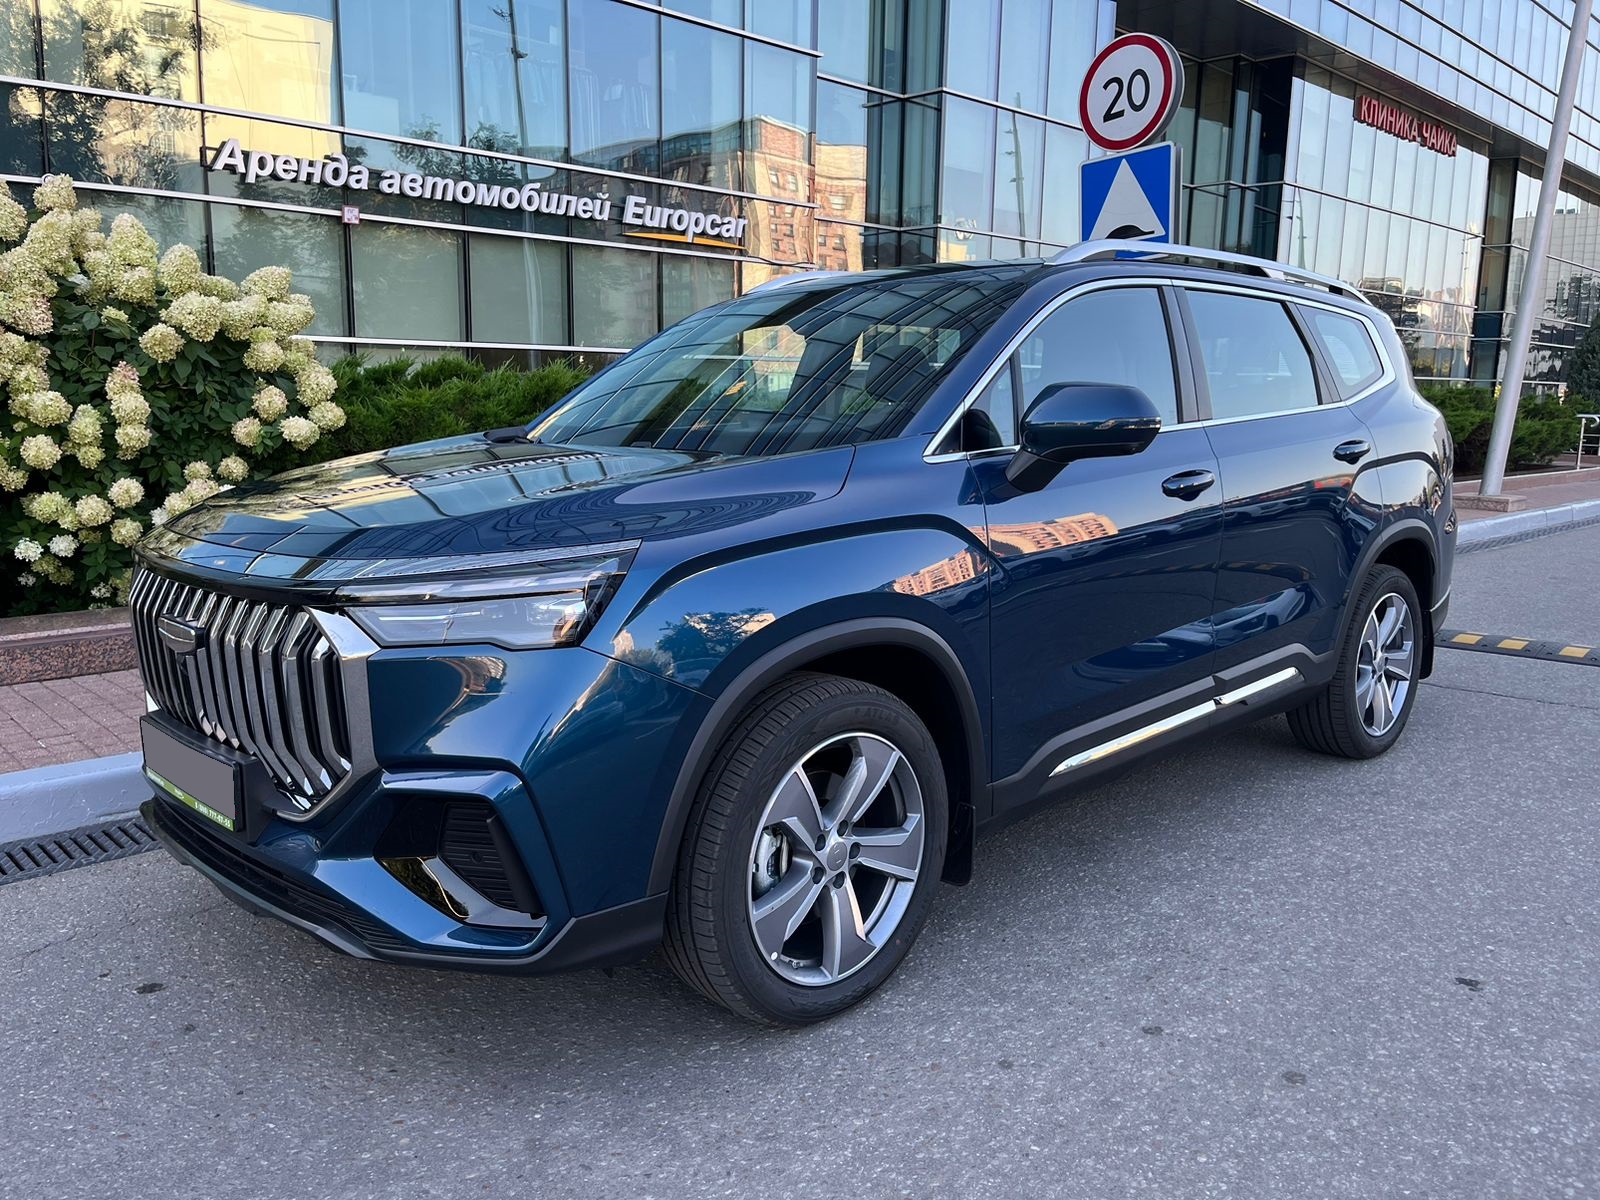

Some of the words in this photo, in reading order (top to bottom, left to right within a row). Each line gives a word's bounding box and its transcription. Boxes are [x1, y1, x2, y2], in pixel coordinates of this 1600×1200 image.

[1102, 68, 1151, 123] 20
[1360, 95, 1419, 141] КЛИНИКА
[1422, 121, 1457, 156] ЧАЙКА
[211, 137, 370, 191] Аренда
[378, 169, 610, 222] автомобилей
[622, 194, 748, 243] Europcar
